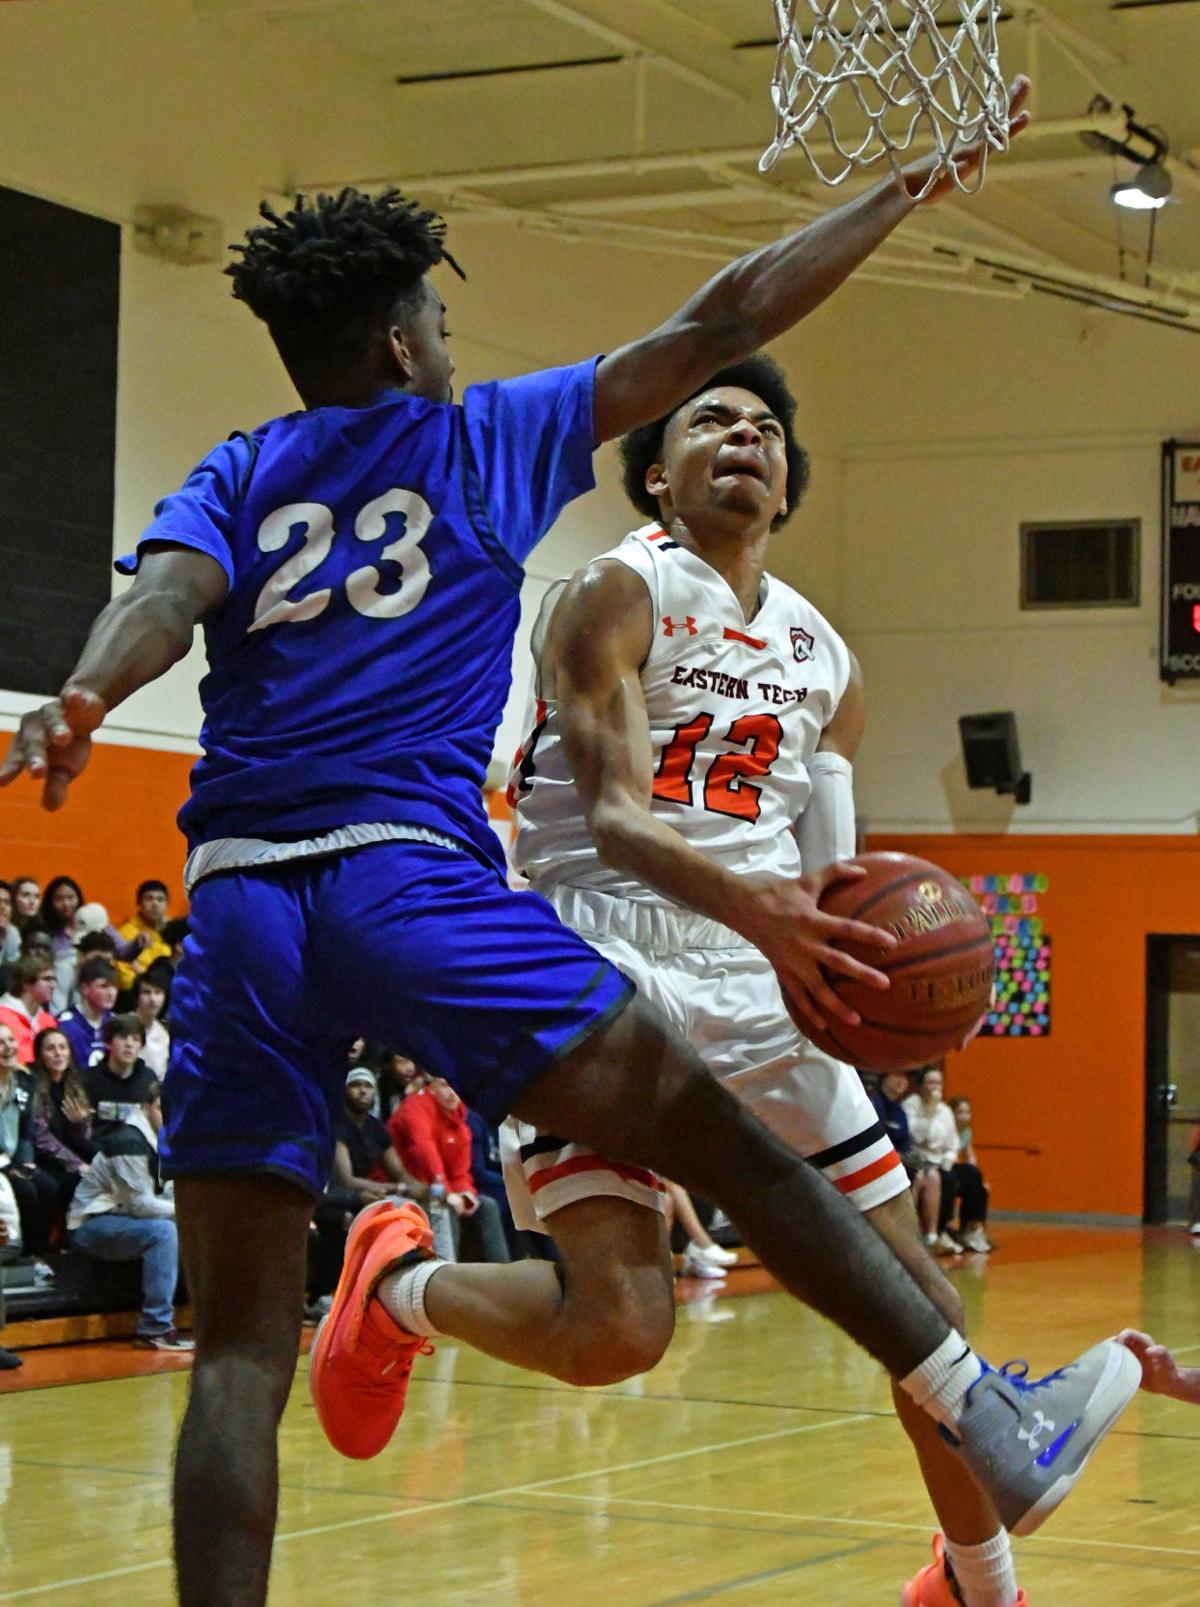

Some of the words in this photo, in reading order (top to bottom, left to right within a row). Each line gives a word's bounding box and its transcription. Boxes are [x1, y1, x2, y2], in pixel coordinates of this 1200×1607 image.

[246, 487, 434, 634] 23
[670, 666, 749, 700] EASTERN
[757, 682, 808, 705] TECH
[651, 711, 784, 824] 12
